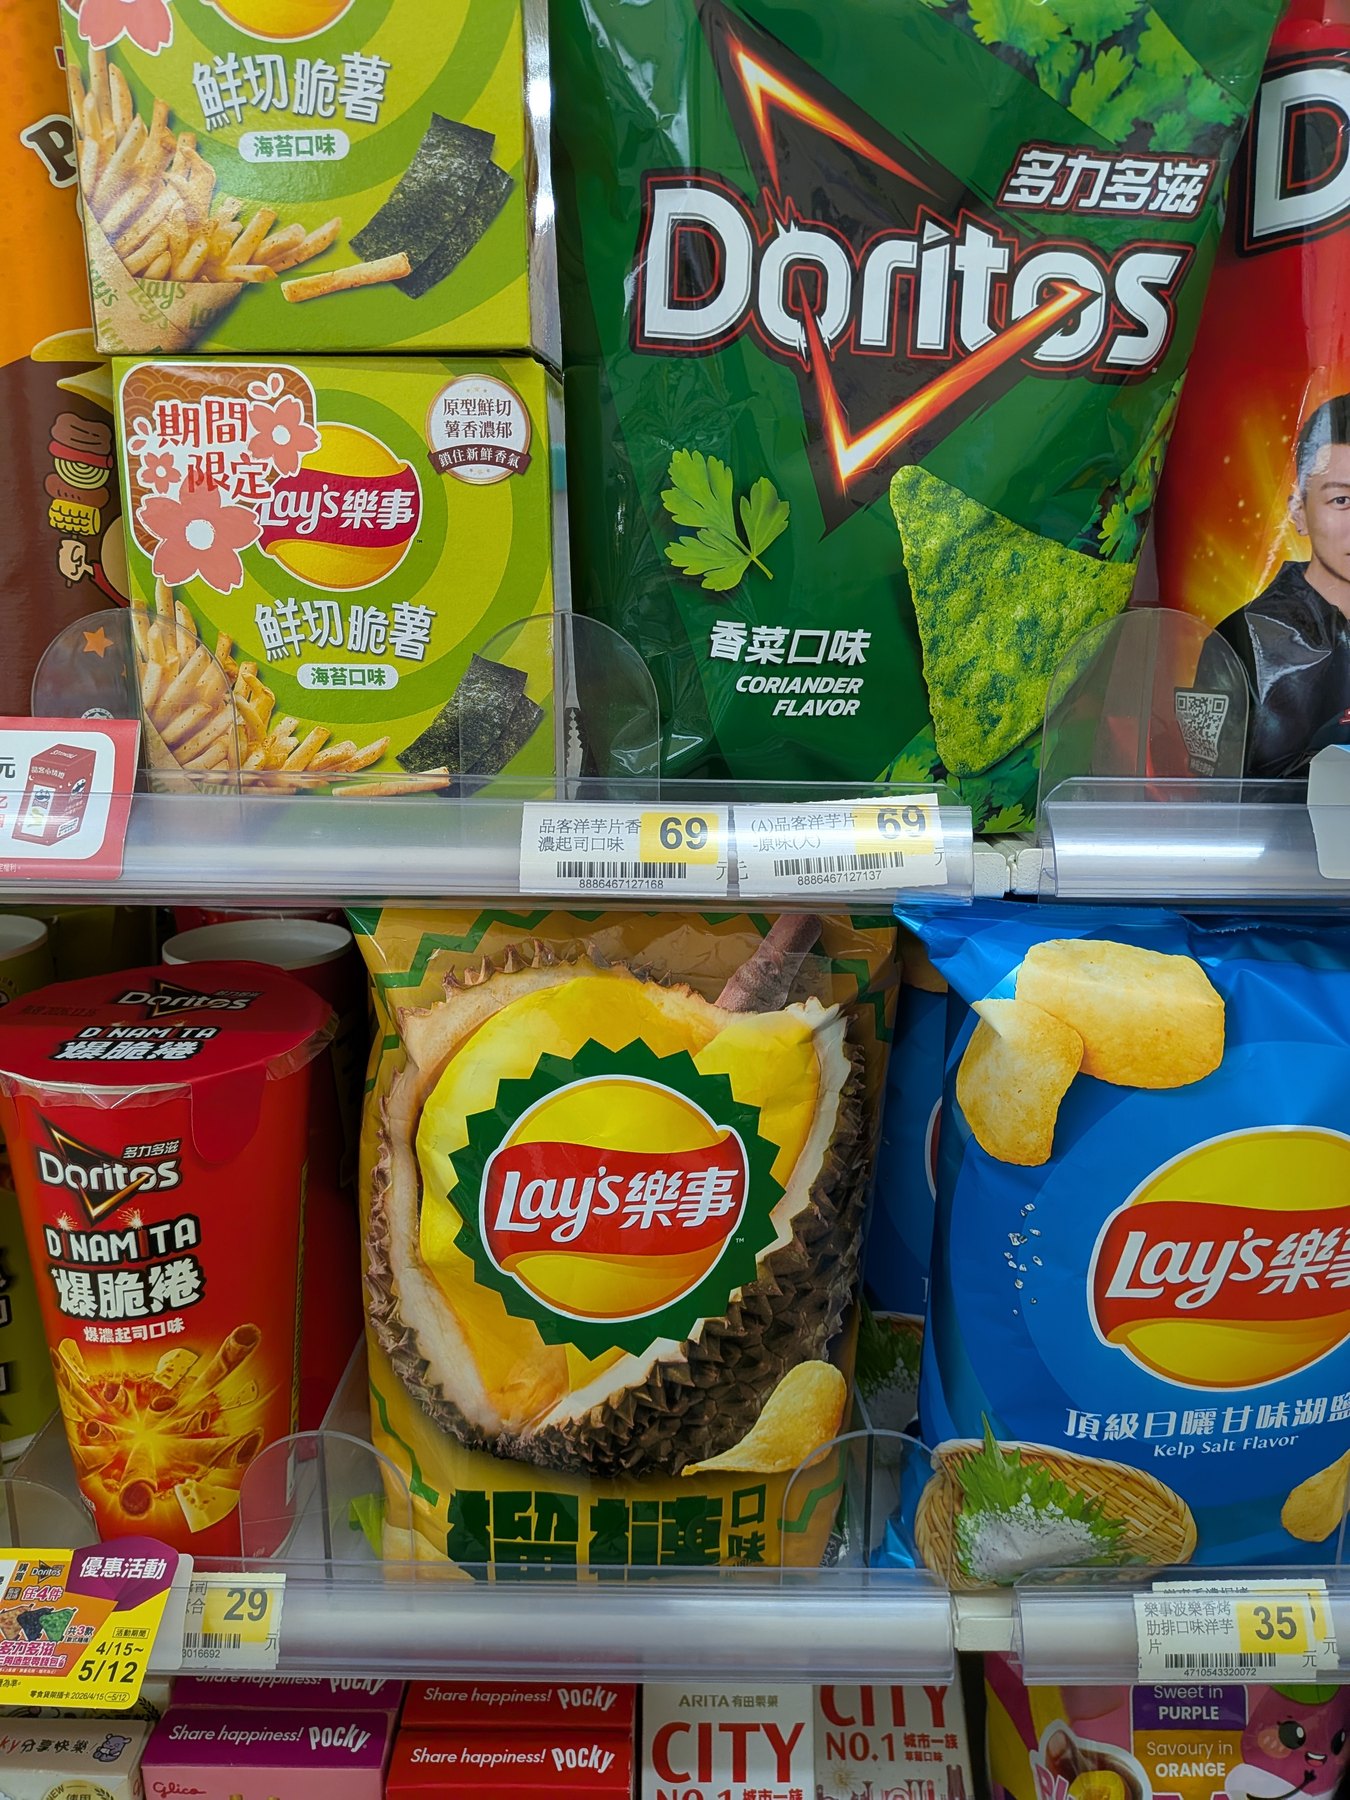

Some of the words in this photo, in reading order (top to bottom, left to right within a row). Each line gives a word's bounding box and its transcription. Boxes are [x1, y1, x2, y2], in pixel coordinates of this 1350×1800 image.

[192, 51, 391, 131] 鮮切脆薯
[253, 136, 337, 158] 海苔口味
[1002, 149, 1209, 213] 多力多滋
[644, 187, 1182, 365] Doritos
[443, 398, 511, 416] 原型鮮切
[156, 400, 248, 448] 期間
[444, 420, 512, 439] 薯香濃郁
[438, 447, 521, 469] 鎖住新鮮香氣
[187, 452, 271, 500] 限定
[340, 489, 416, 530] 樂事
[254, 598, 437, 662] 鮮切脆薯
[710, 620, 872, 666] 香菜口味
[310, 667, 387, 687] 海苔口味
[736, 675, 864, 694] CORIANDER
[772, 699, 861, 717] FLAVOR
[539, 818, 642, 835] 品客洋芋片香
[877, 805, 926, 839] 69
[659, 816, 709, 850] 69
[537, 836, 625, 852] 濃起司口味
[579, 879, 664, 889] 8886467127168
[797, 870, 882, 886] 8886467127137
[118, 991, 250, 1009] Doritos
[122, 1140, 180, 1158] 多力多滋
[39, 1151, 180, 1191] Doritos
[494, 1166, 624, 1242] Lay's
[619, 1167, 739, 1229] 樂事
[1104, 1227, 1273, 1310] Lay's
[83, 1317, 186, 1343] 爆濃起司口味
[1154, 1441, 1194, 1459] Kelp
[1201, 1439, 1236, 1454] Salt
[1242, 1433, 1299, 1450] Flavor
[80, 1556, 167, 1579] 優惠活動
[223, 1587, 268, 1621] 29
[1144, 1601, 1232, 1618] 樂事波樂香烤
[1146, 1618, 1234, 1637] 肋排口味洋芋
[1253, 1606, 1298, 1641] 35
[96, 1642, 144, 1656] 4/15~
[1149, 1639, 1162, 1655] 片
[78, 1660, 138, 1683] 5/12
[1184, 1667, 1257, 1677] 4710543320072
[424, 1687, 468, 1701] Share
[471, 1687, 552, 1706] happiness!
[678, 1695, 730, 1707] ARITA
[1154, 1686, 1204, 1699] Sweet
[1208, 1686, 1223, 1699] in
[1158, 1706, 1219, 1721] PURPLE
[169, 1725, 216, 1741] Share
[218, 1725, 304, 1745] happiness!
[652, 1722, 805, 1783] CITY
[826, 1731, 895, 1762] NO.1
[904, 1733, 958, 1749] 城市一族
[1147, 1741, 1212, 1760] Savoury
[1218, 1741, 1233, 1756] in
[411, 1748, 457, 1763] Share
[460, 1748, 546, 1768] happiness!
[1155, 1762, 1226, 1777] ORANGE
[152, 1781, 207, 1798] Glico
